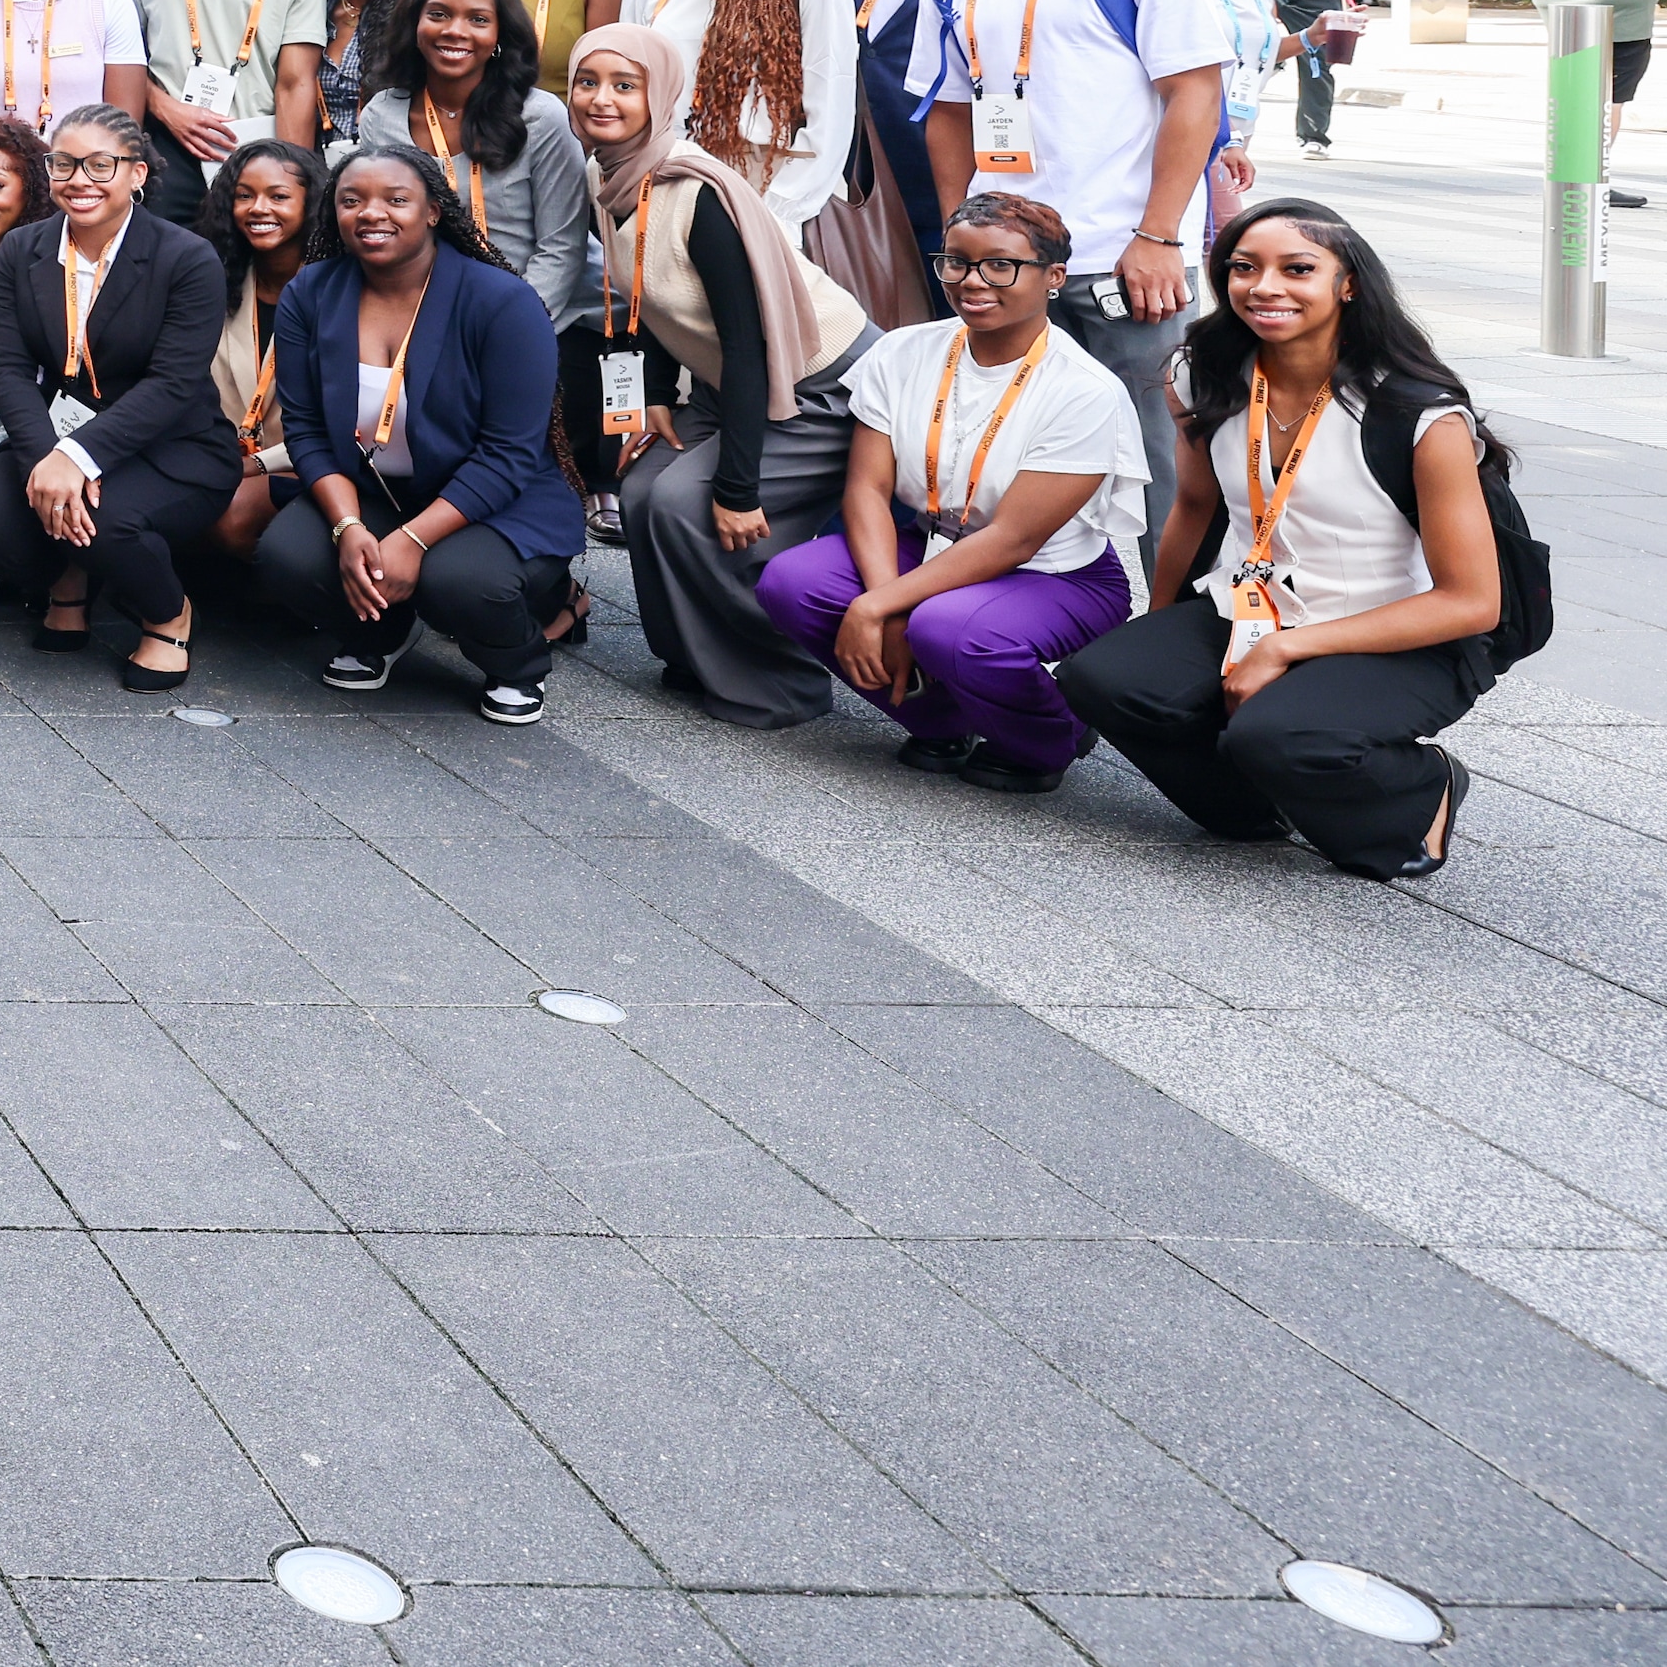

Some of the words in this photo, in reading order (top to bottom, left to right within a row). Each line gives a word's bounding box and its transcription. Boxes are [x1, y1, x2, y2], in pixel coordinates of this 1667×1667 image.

[1019, 23, 1028, 58] AFROTECH
[200, 83, 219, 92] DAVID
[428, 107, 437, 127] PREMIER
[642, 179, 651, 202] PREMIER
[1562, 190, 1588, 267] MEXICO
[946, 334, 962, 369] AFROTECH
[613, 376, 633, 384] YASMIN
[1014, 363, 1031, 387] PREMIER
[1255, 377, 1265, 404] PREMIER
[1310, 382, 1331, 416] AFROTEC
[251, 394, 262, 415] PREMIER
[383, 403, 393, 427] PREMIER
[933, 399, 945, 424] PREMIER
[983, 415, 1004, 451] AFROTECH
[1253, 438, 1261, 481] AFROTECH
[1285, 448, 1302, 475] PREMIER
[926, 456, 934, 493] AFROTECH
[1255, 506, 1275, 547] AFROTECH
